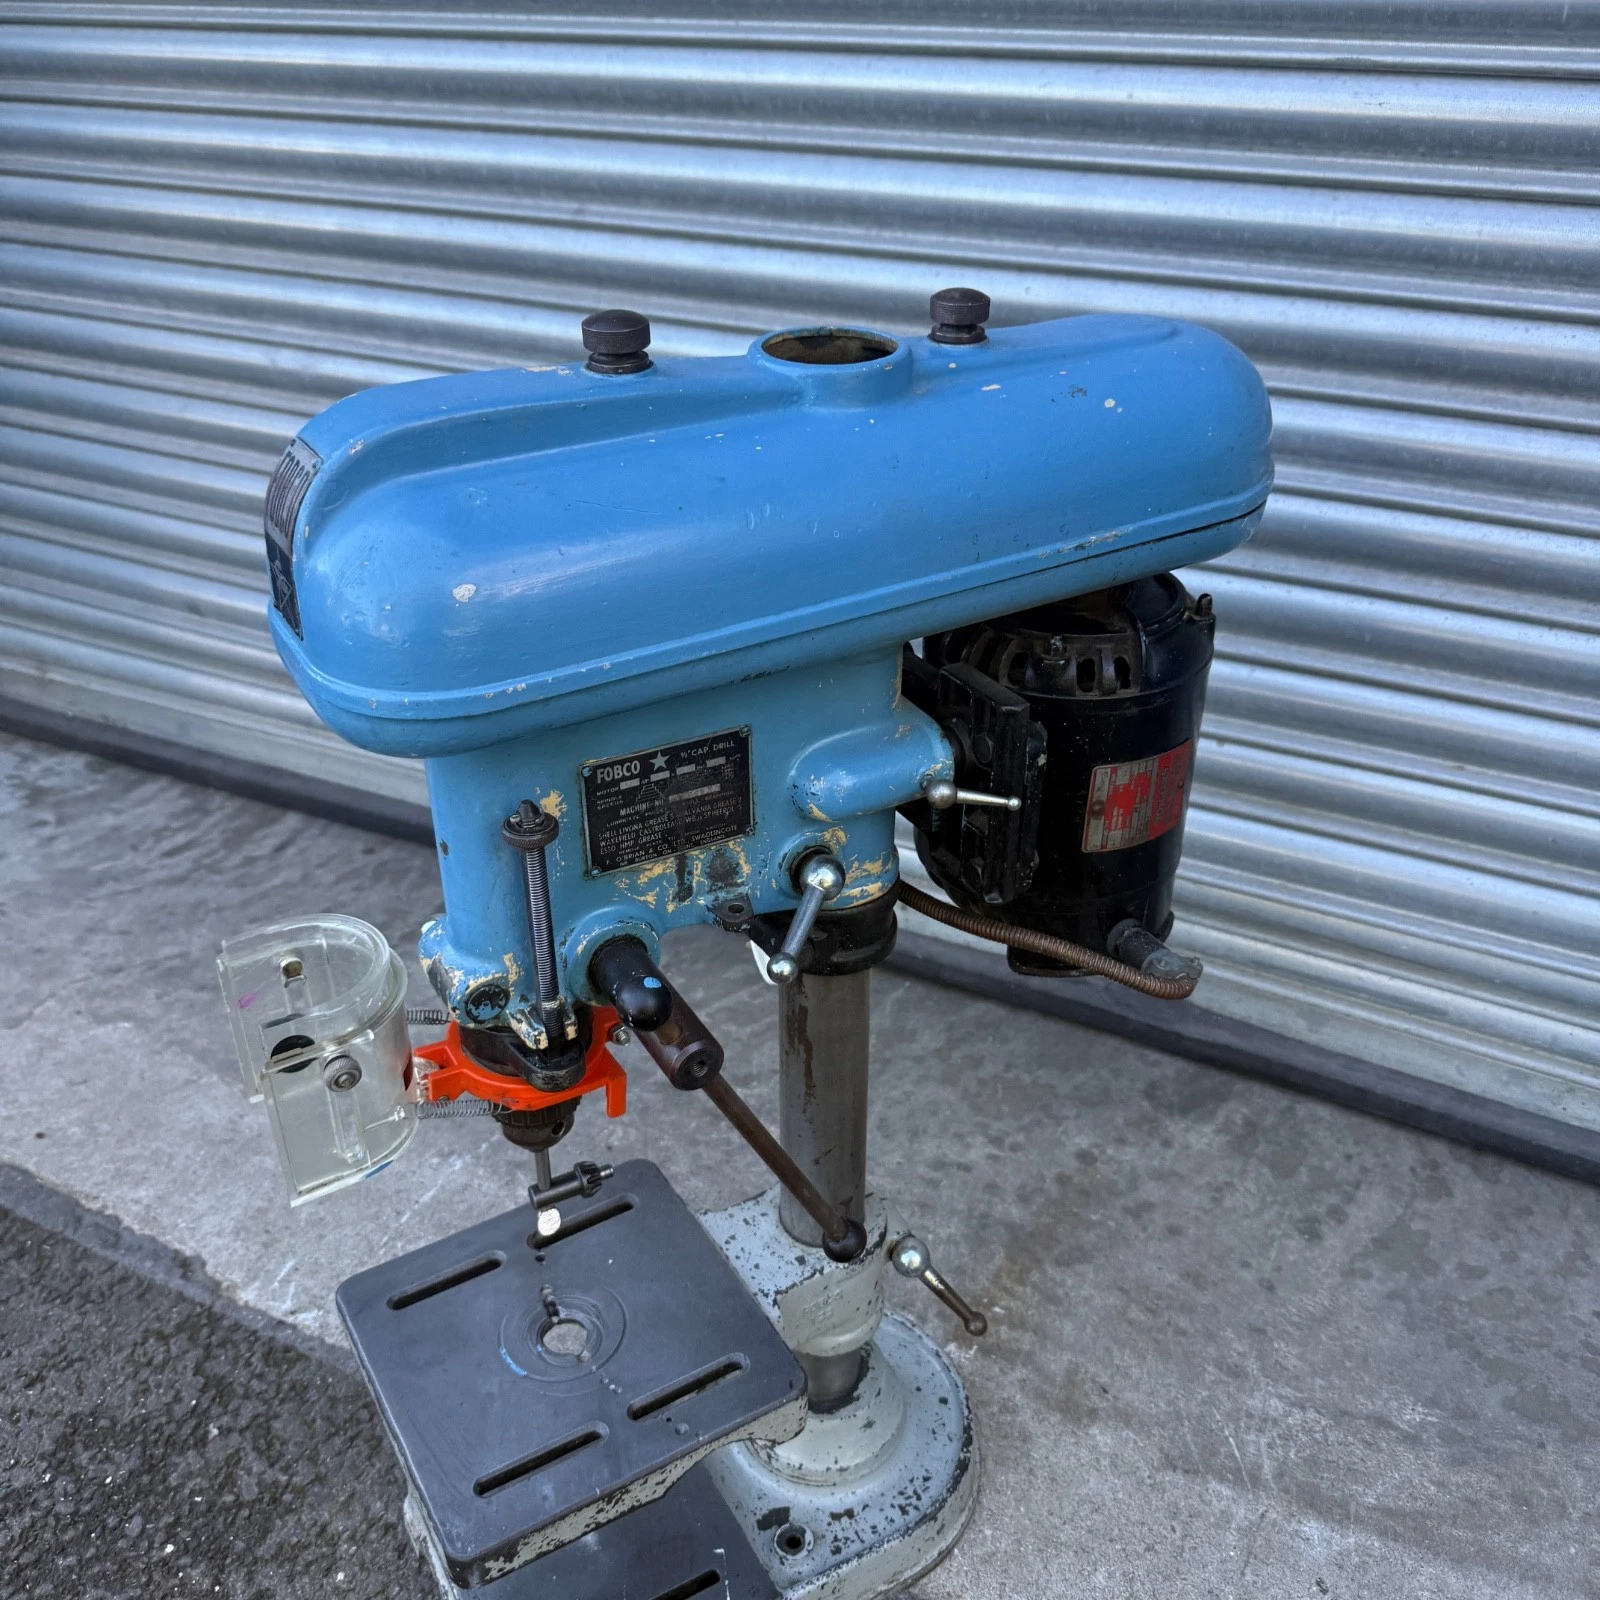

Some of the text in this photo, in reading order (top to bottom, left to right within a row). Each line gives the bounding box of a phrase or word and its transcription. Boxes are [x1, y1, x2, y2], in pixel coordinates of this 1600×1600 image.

[713, 740, 735, 751] DRILL
[596, 760, 641, 783] FOBCO
[598, 828, 617, 839] SHELL
[643, 814, 669, 827] GREASE
[599, 831, 636, 847] WAKEFIELD
[599, 844, 616, 854] ESSO
[619, 839, 635, 849] HMP
[615, 849, 645, 862] O'BRIAN
